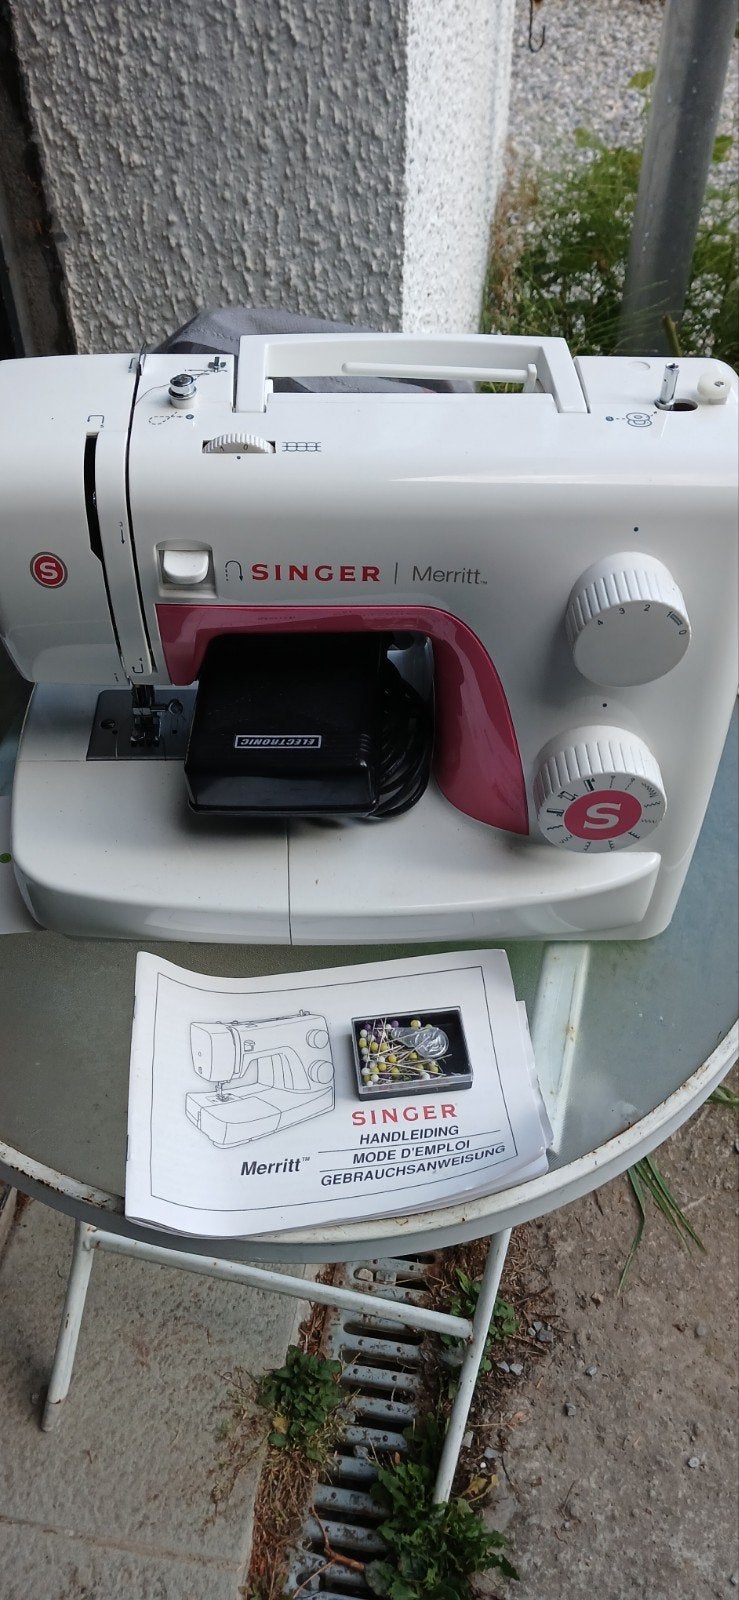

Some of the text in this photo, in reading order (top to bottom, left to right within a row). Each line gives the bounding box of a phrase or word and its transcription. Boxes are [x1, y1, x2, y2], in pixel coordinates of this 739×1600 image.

[40, 562, 58, 580] S
[251, 563, 381, 582] SINGER
[619, 607, 626, 615] 3
[644, 604, 651, 612] 2
[240, 738, 316, 746] ELECTRONIC
[583, 802, 622, 830] S
[351, 1103, 458, 1126] SINGER
[359, 1125, 460, 1145] HANDLEIDING
[352, 1139, 471, 1165] MODE D'EMPLOI
[320, 1144, 507, 1187] GEBRAUCHSANWEISUNG
